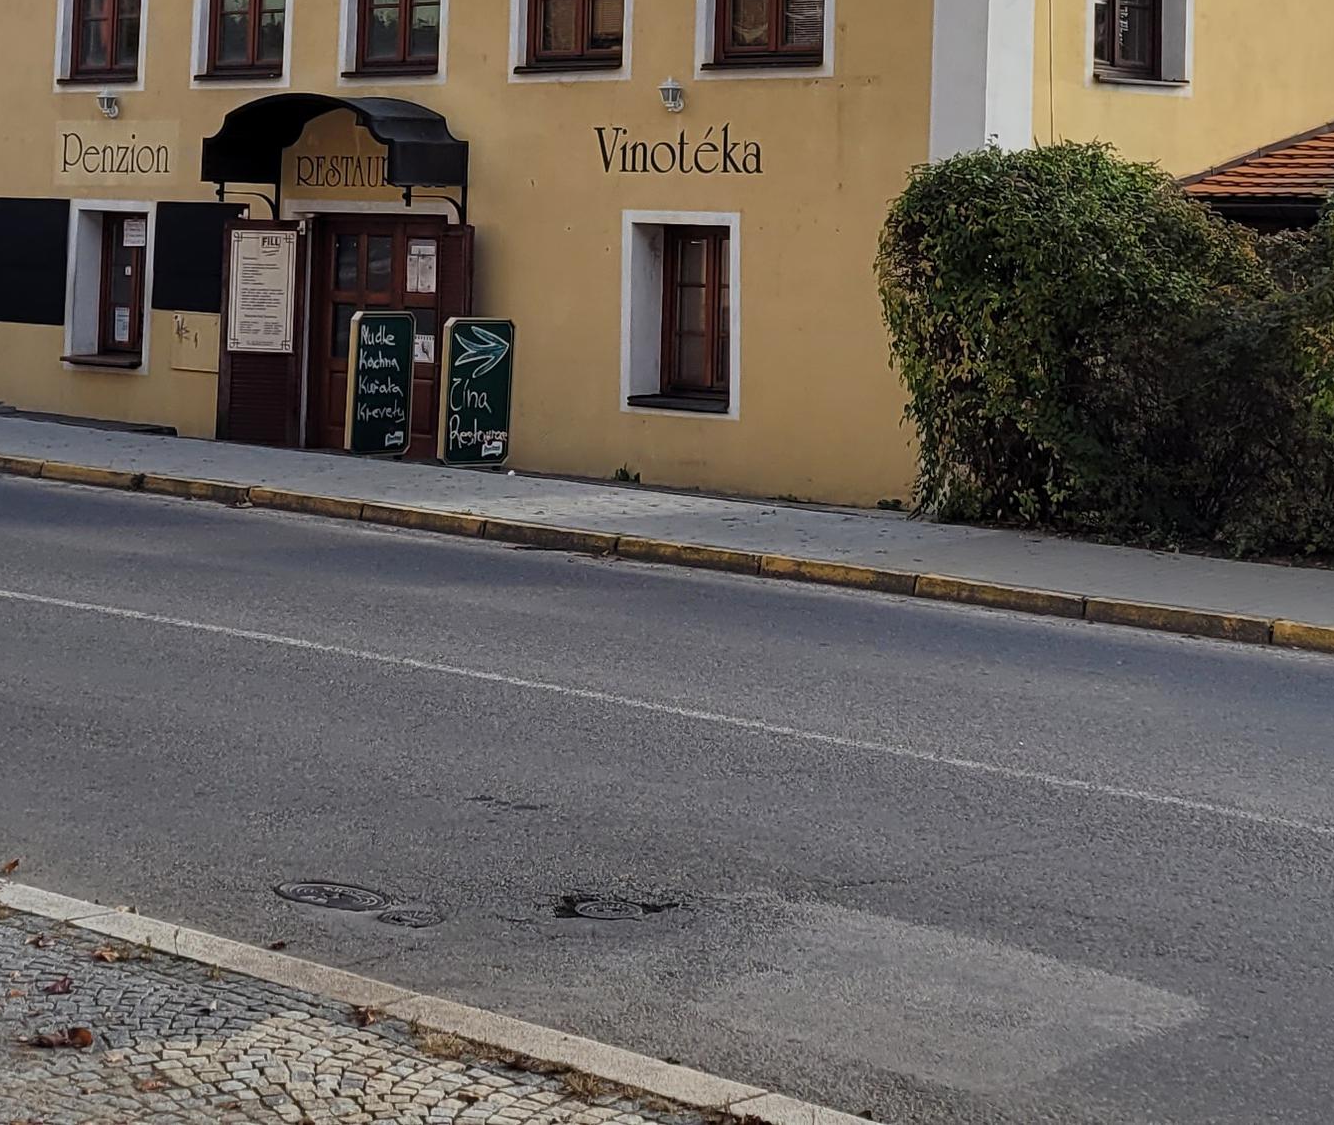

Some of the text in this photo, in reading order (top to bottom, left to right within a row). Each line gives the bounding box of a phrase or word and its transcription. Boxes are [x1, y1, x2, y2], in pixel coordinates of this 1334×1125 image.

[60, 132, 171, 175] Penzion
[593, 122, 763, 174] Vinotéka
[360, 326, 396, 346] Nudle
[356, 399, 406, 424] Krevety
